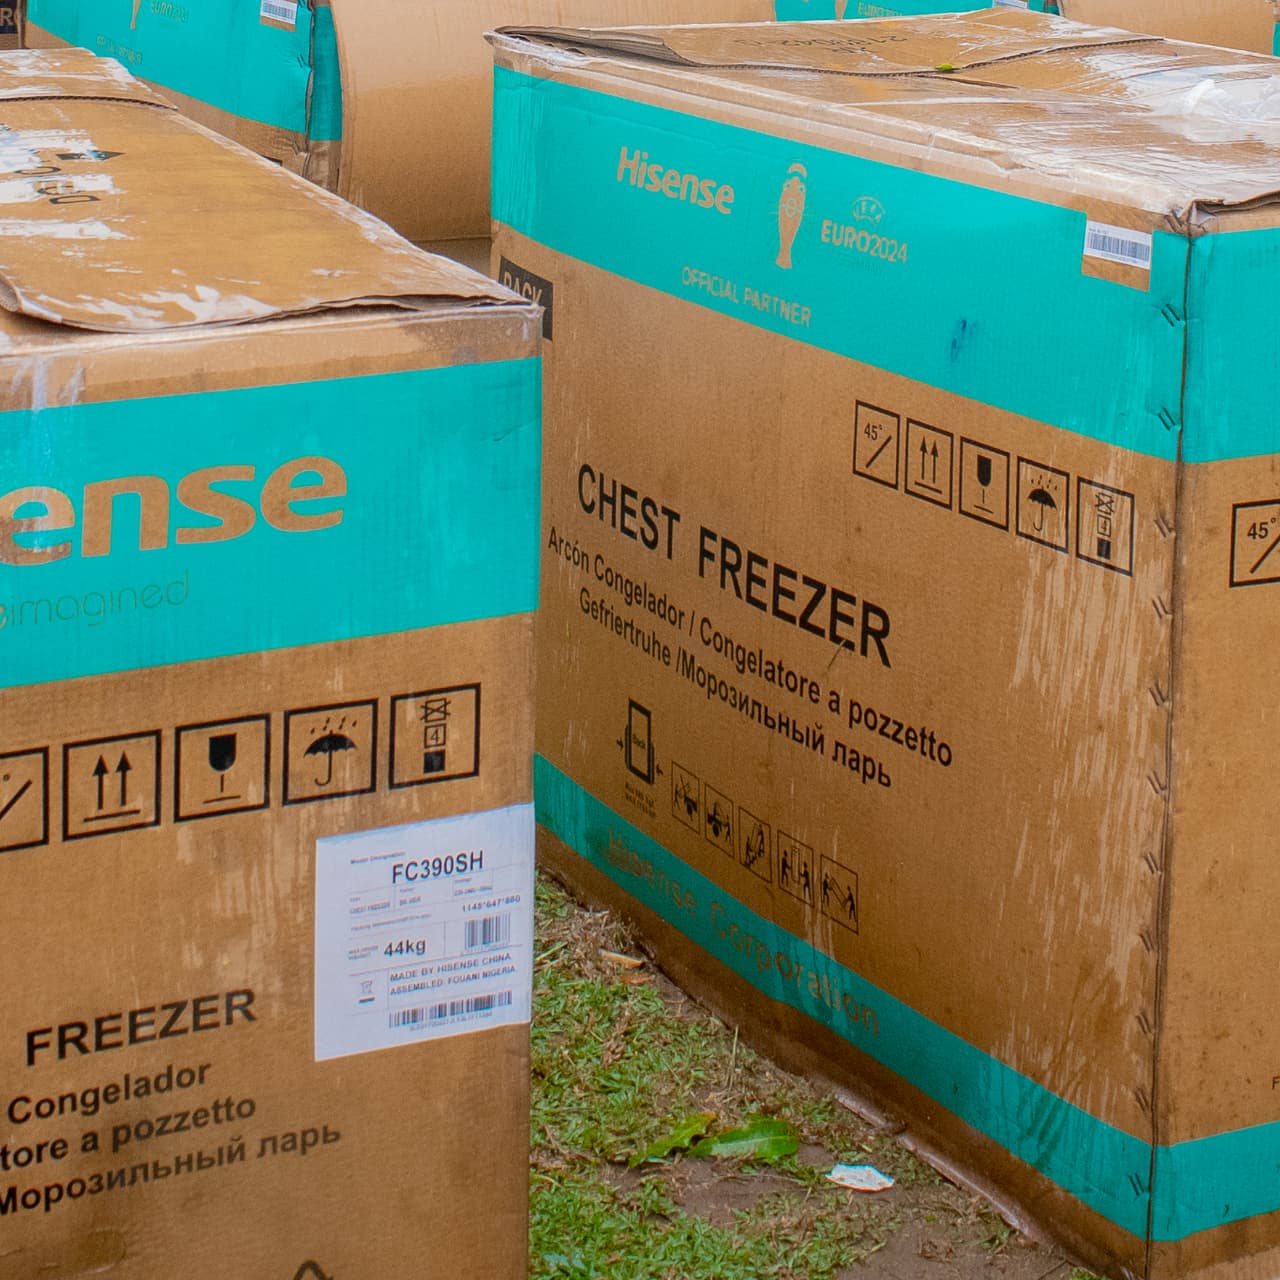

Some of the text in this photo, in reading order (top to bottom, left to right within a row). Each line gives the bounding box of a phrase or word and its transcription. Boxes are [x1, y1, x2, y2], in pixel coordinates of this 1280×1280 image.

[617, 145, 735, 215] Hisense
[821, 219, 907, 264] EURO2024
[681, 266, 812, 328] OFFICIAL PARTNER
[577, 463, 891, 669] CHEST FREEZER
[547, 526, 590, 575] Arcón
[594, 553, 686, 638] Congelador
[699, 622, 821, 705] Congelatore
[828, 687, 841, 713] a
[849, 696, 954, 768] pozzetto
[578, 588, 673, 668] Gefriertruhe
[831, 739, 893, 789] ларь
[392, 850, 484, 884] FC390SH
[383, 939, 426, 956] 44kg
[390, 952, 512, 982] MADE BY HISENSE CHINA
[482, 965, 517, 979] NIGERIA
[709, 900, 882, 1037] Corporation
[25, 988, 258, 1067] FREEZER
[7, 1062, 212, 1128] Congelador
[80, 1131, 101, 1155] a
[110, 1093, 258, 1154] pozzetto
[256, 1124, 342, 1168] ларь
